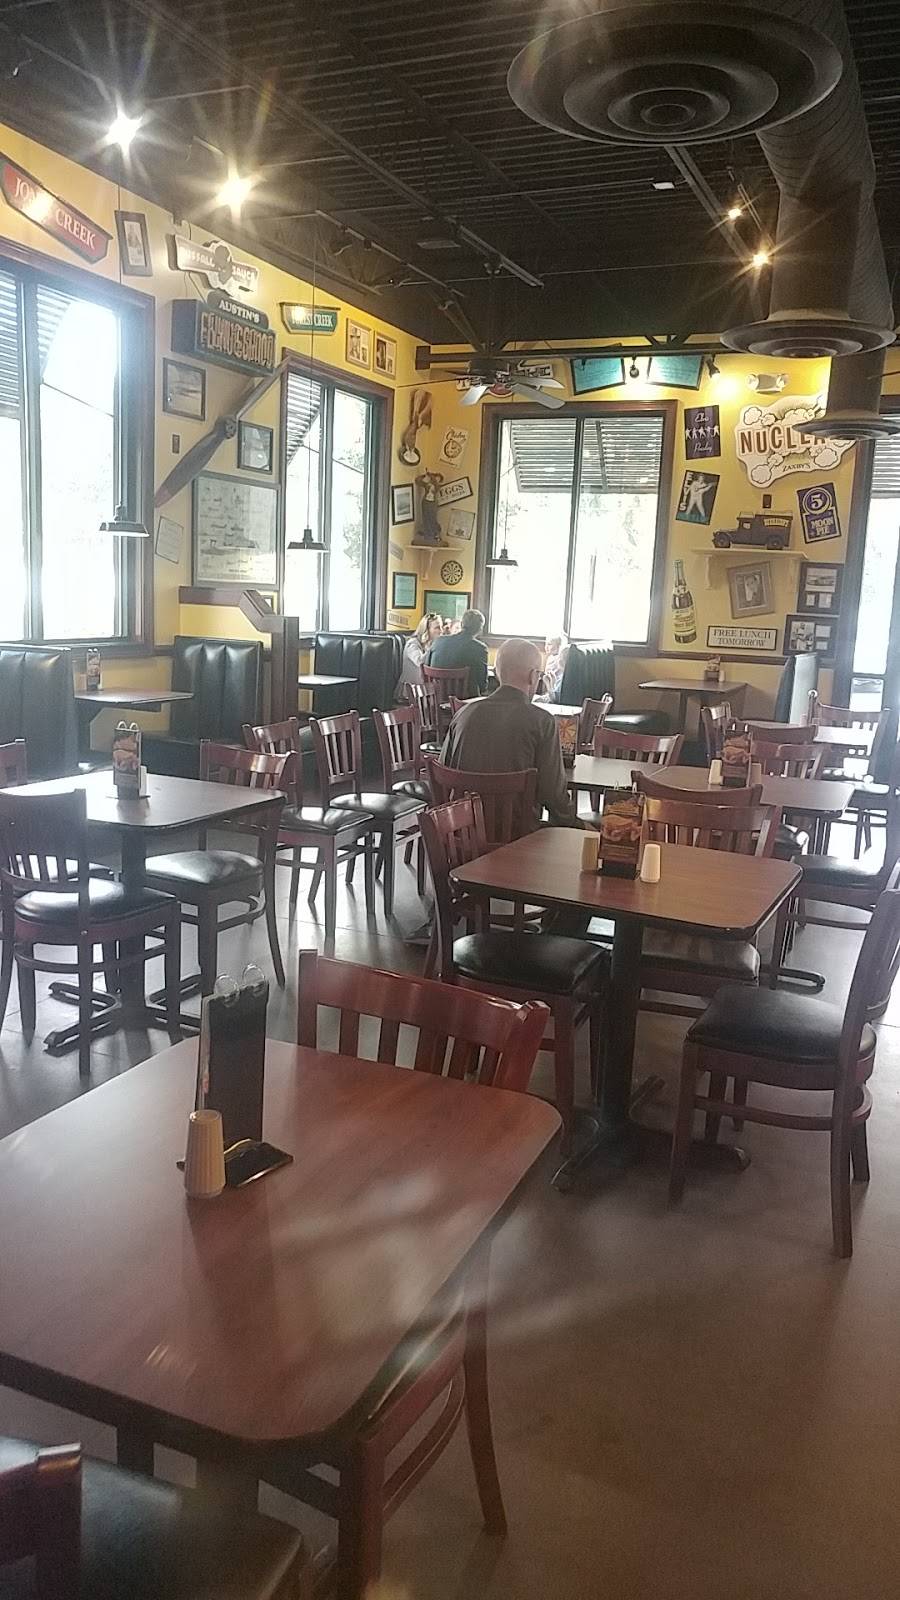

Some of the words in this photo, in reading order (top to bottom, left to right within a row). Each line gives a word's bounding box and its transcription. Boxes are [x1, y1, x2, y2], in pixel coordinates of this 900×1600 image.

[56, 209, 96, 250] CREEK
[219, 300, 260, 323] AUSTIN'S
[291, 310, 313, 326] EST
[314, 313, 333, 327] CREEK
[782, 463, 811, 472] ZAXBY'S
[679, 471, 693, 511] ELVIS
[810, 516, 834, 529] MOON
[816, 525, 831, 536] PIE
[713, 628, 737, 638] FREE
[740, 630, 771, 639] LUNCH
[717, 637, 766, 647] TOMORROW
